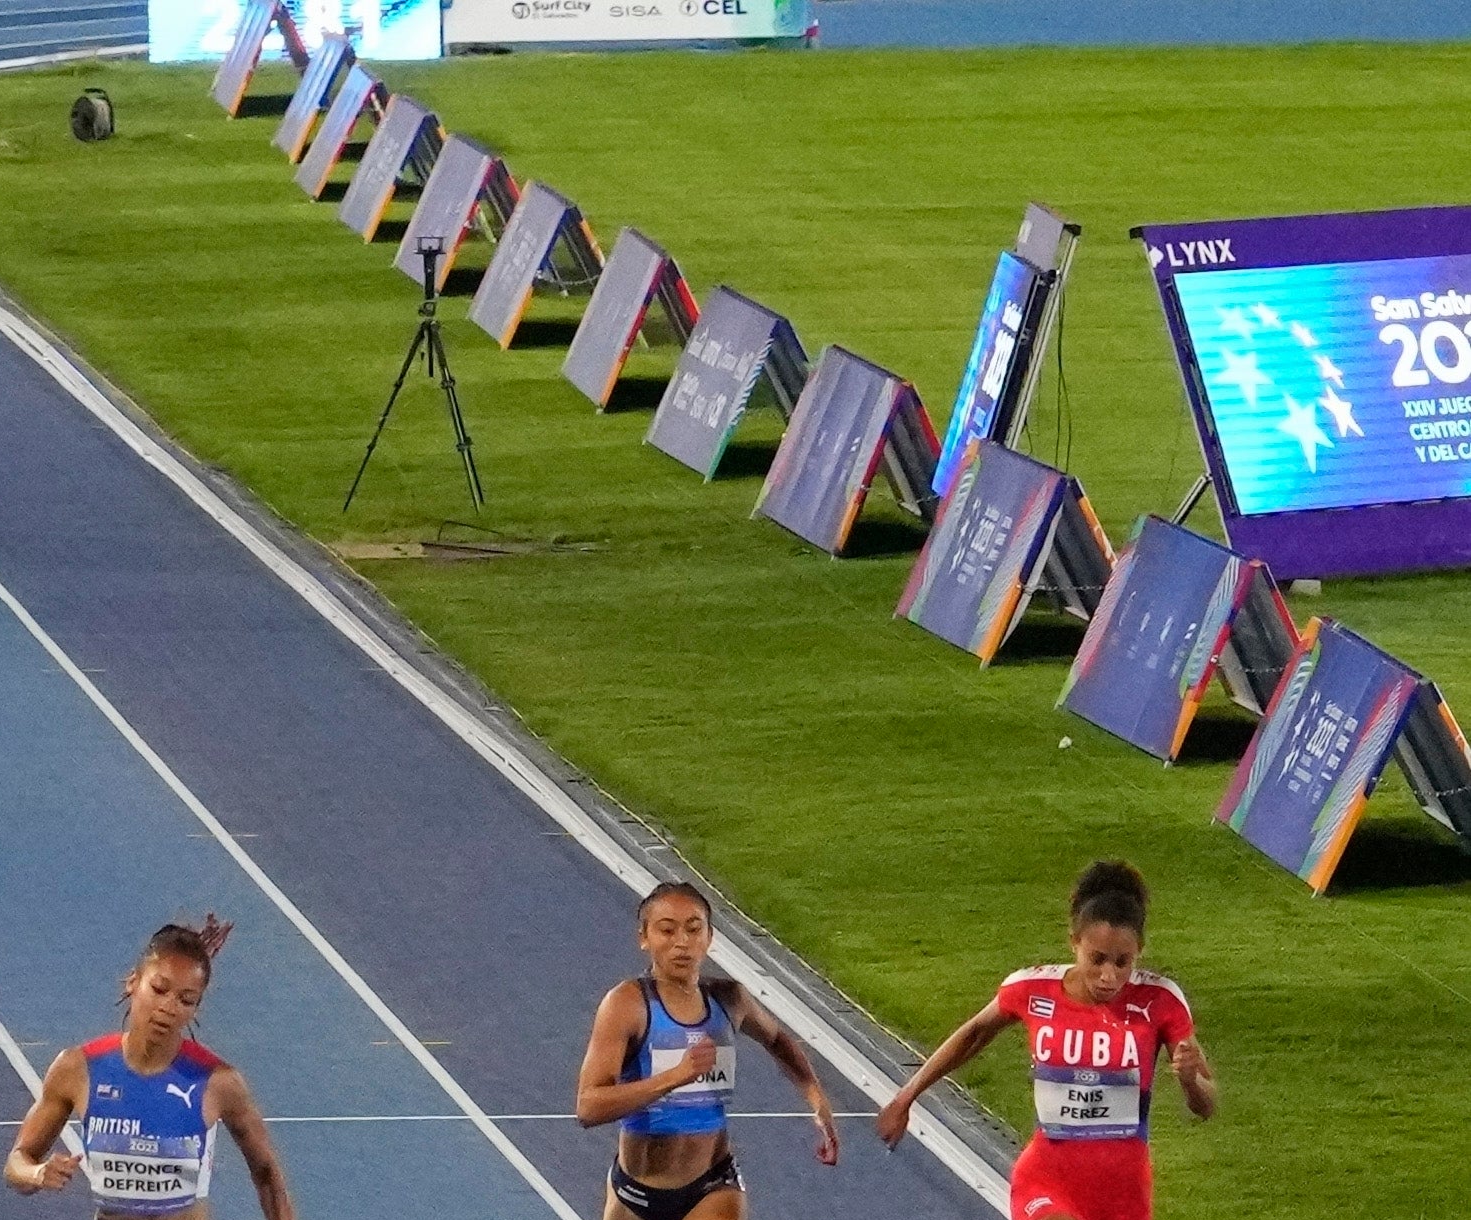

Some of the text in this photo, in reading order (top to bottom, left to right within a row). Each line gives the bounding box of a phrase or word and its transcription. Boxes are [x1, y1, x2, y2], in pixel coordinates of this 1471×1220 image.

[532, 0, 591, 12] Surf City
[609, 6, 662, 17] SISA
[703, 0, 747, 15] CEL
[1165, 239, 1236, 267] LYNX
[1370, 295, 1421, 321] San
[1378, 320, 1471, 388] 20
[1402, 399, 1436, 418] XXIV
[1415, 446, 1426, 463] Y
[1428, 444, 1459, 463] DEL
[1036, 1026, 1140, 1067] CUBA
[695, 1070, 727, 1084] ONA
[1068, 1089, 1103, 1103] ENIS
[1060, 1106, 1110, 1119] PEREZ
[87, 1115, 141, 1144] BRITISH
[129, 1140, 159, 1153] 2023
[103, 1160, 183, 1175] BEYONCE
[103, 1177, 182, 1192] DEFREITA
